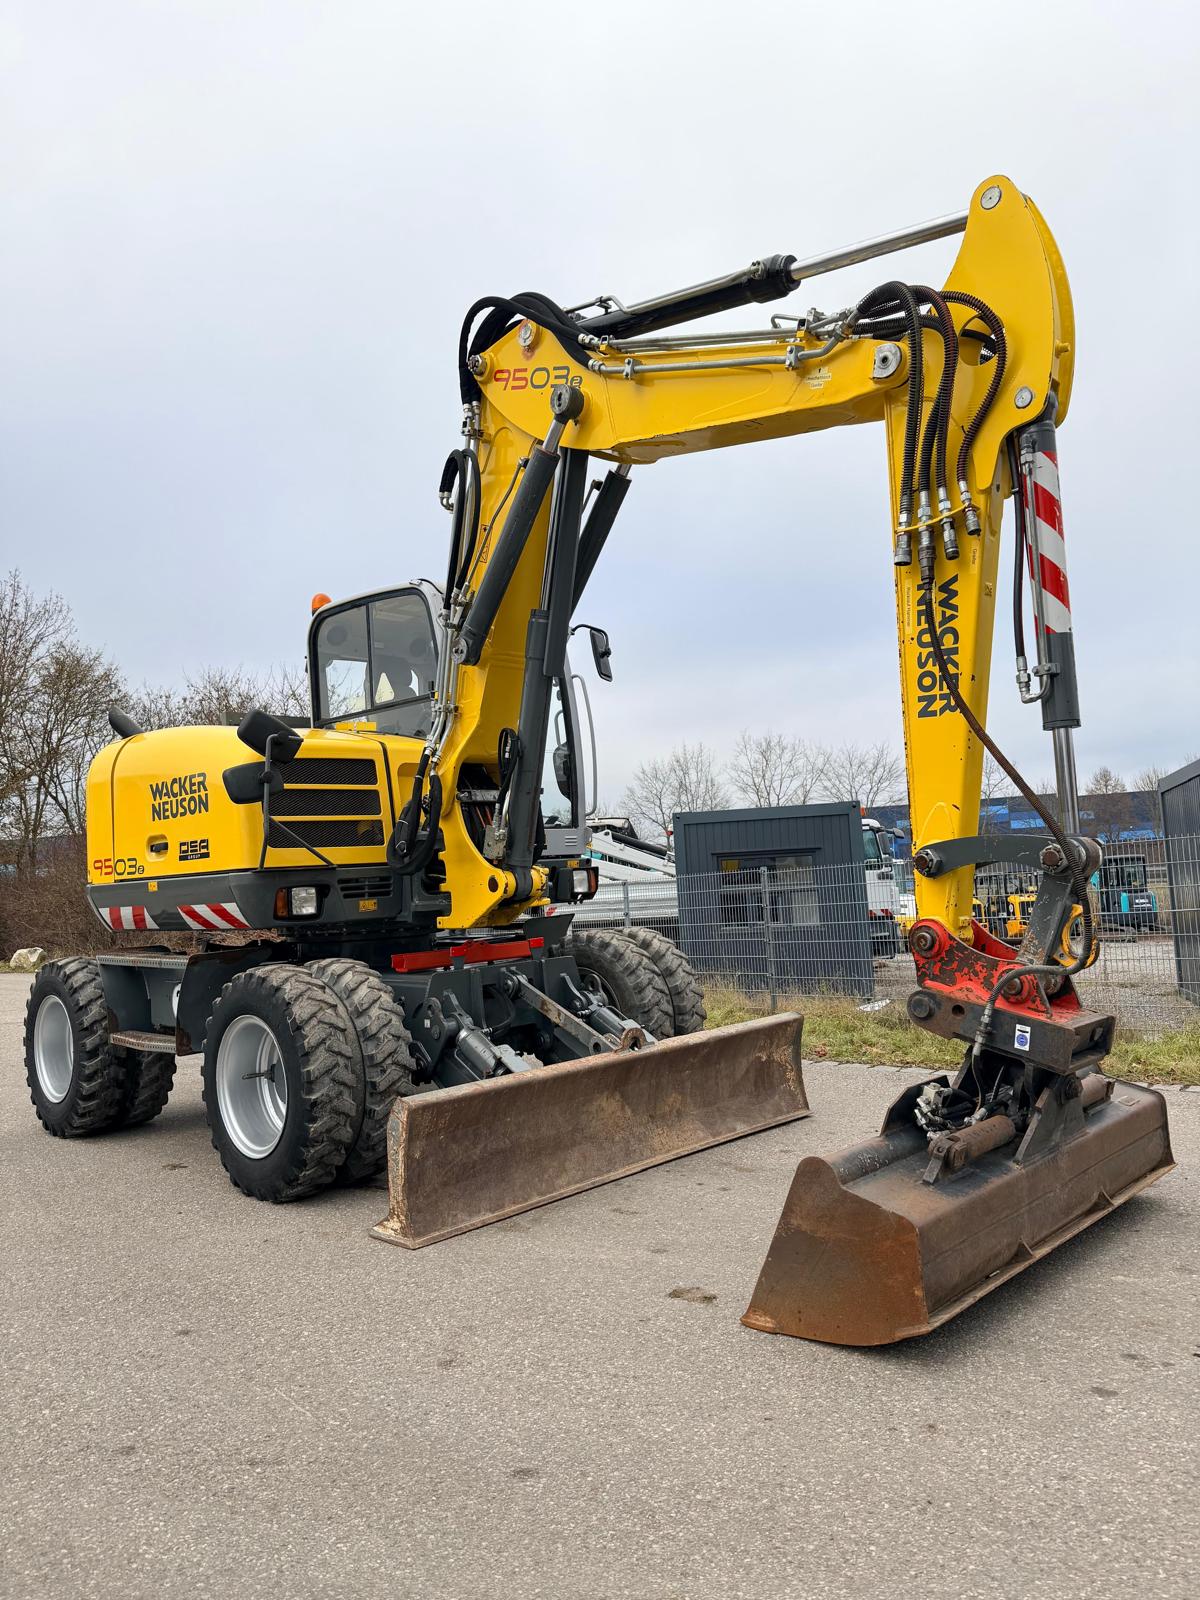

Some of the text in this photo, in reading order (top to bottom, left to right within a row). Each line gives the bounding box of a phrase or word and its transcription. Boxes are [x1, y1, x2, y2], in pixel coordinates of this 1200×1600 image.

[916, 583, 938, 719] NEUSON
[938, 573, 960, 717] WACKER
[150, 772, 208, 801] WACKER
[151, 793, 209, 822] NEUSON
[180, 839, 209, 854] DEA
[93, 857, 145, 877] 9503e
